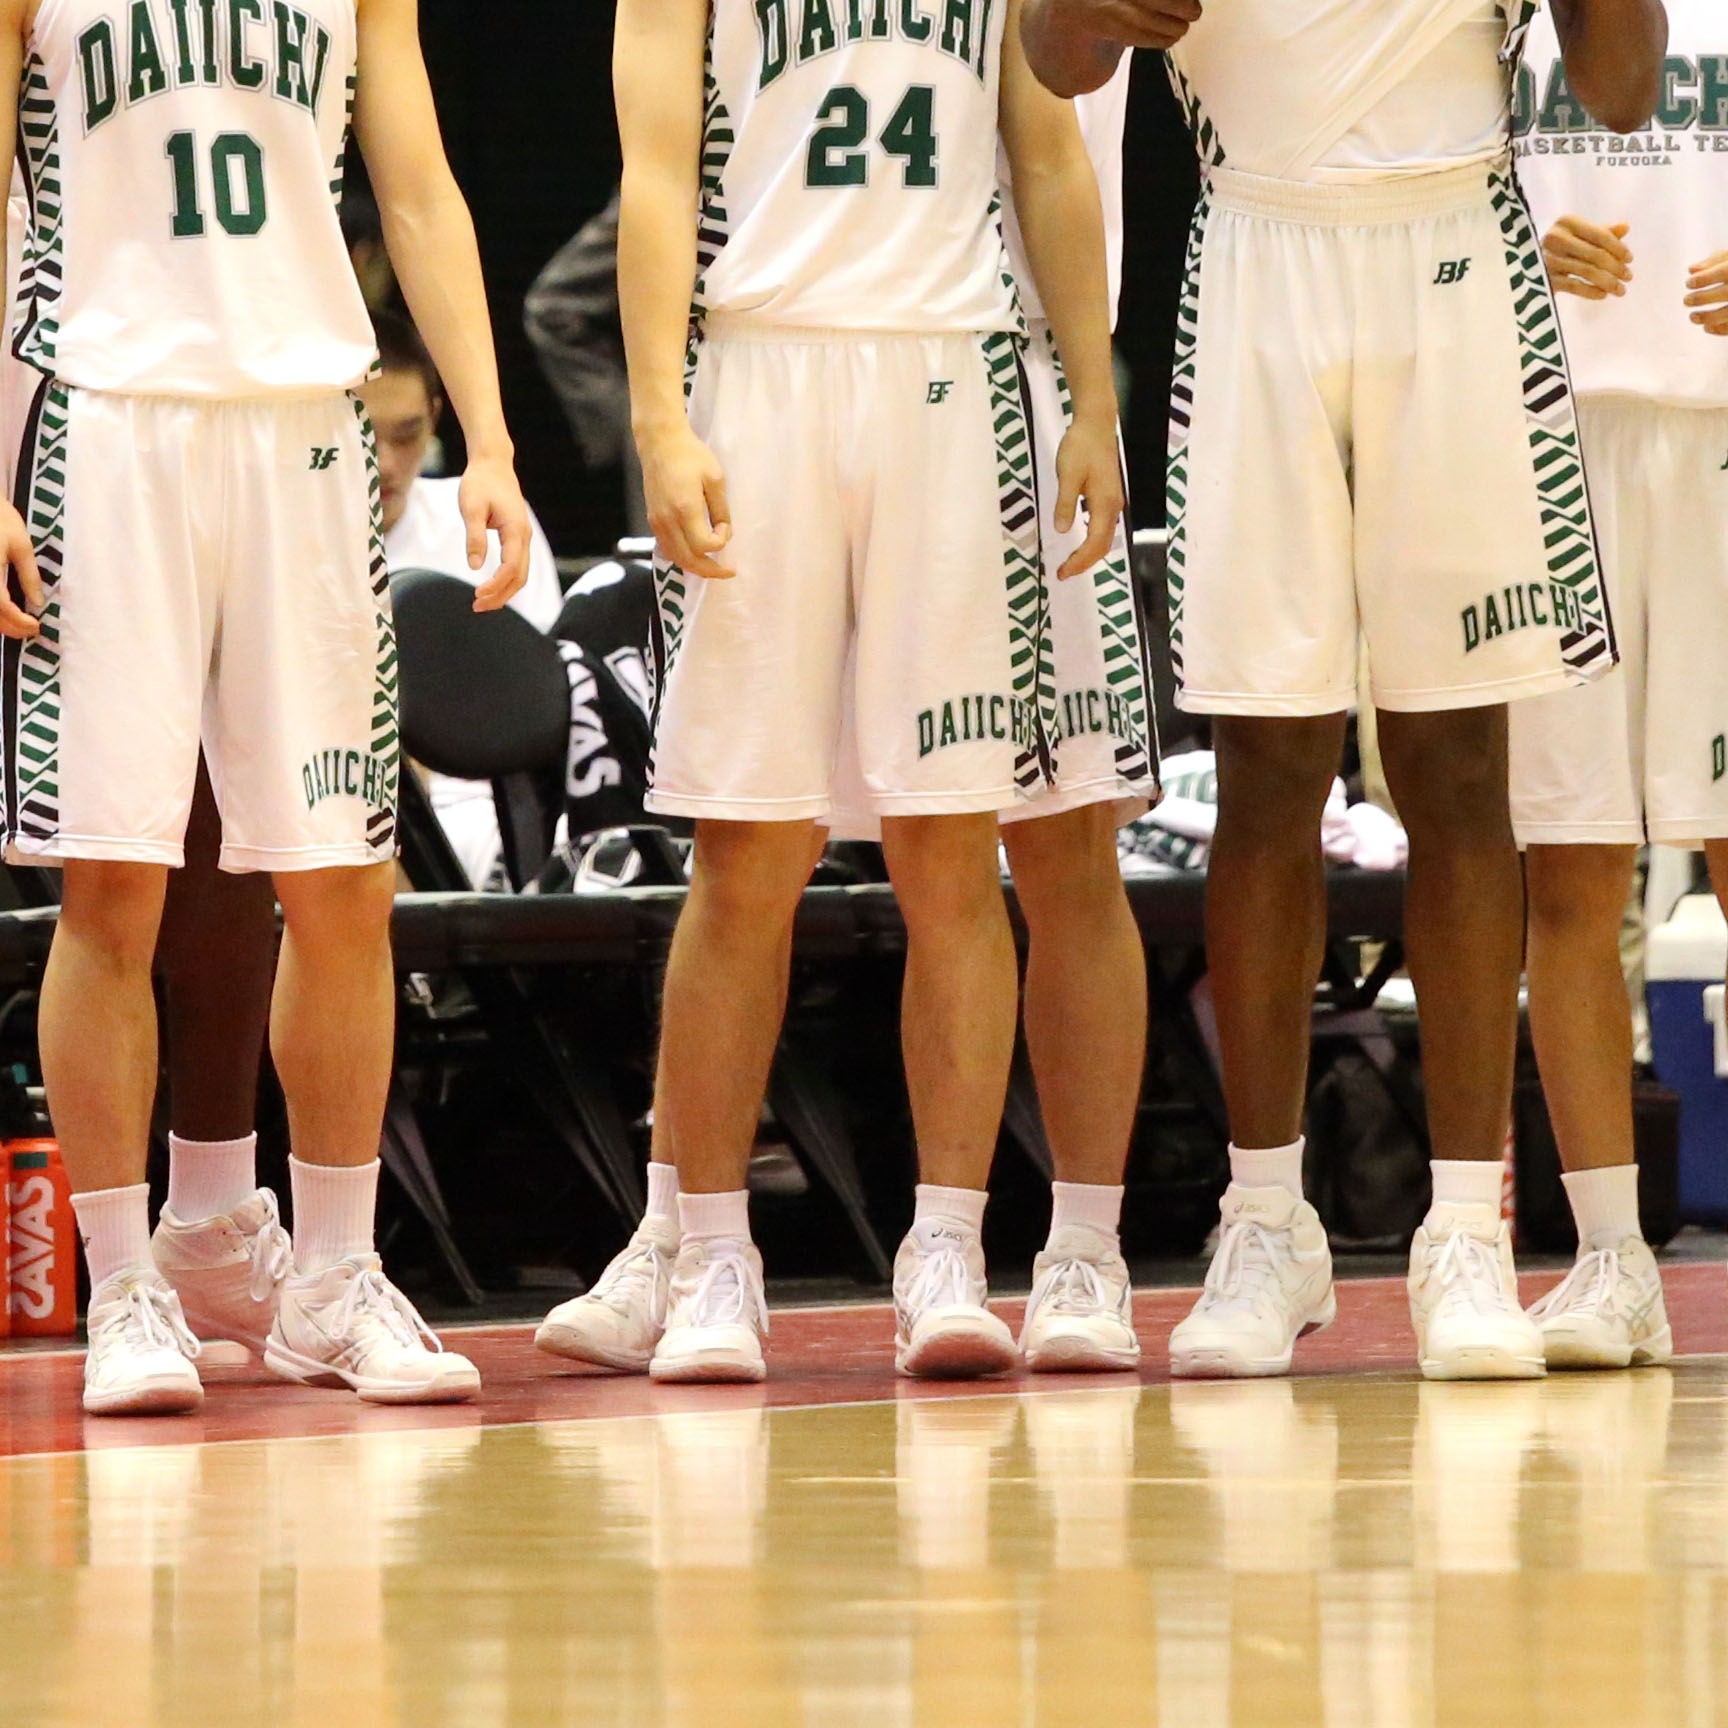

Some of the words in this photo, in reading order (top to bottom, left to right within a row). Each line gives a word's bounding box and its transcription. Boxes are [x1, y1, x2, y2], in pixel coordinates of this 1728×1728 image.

[803, 83, 940, 190] 24
[1596, 155, 1673, 167] FUKUOKA
[164, 129, 269, 240] 10
[1461, 583, 1587, 653] DAIICHI
